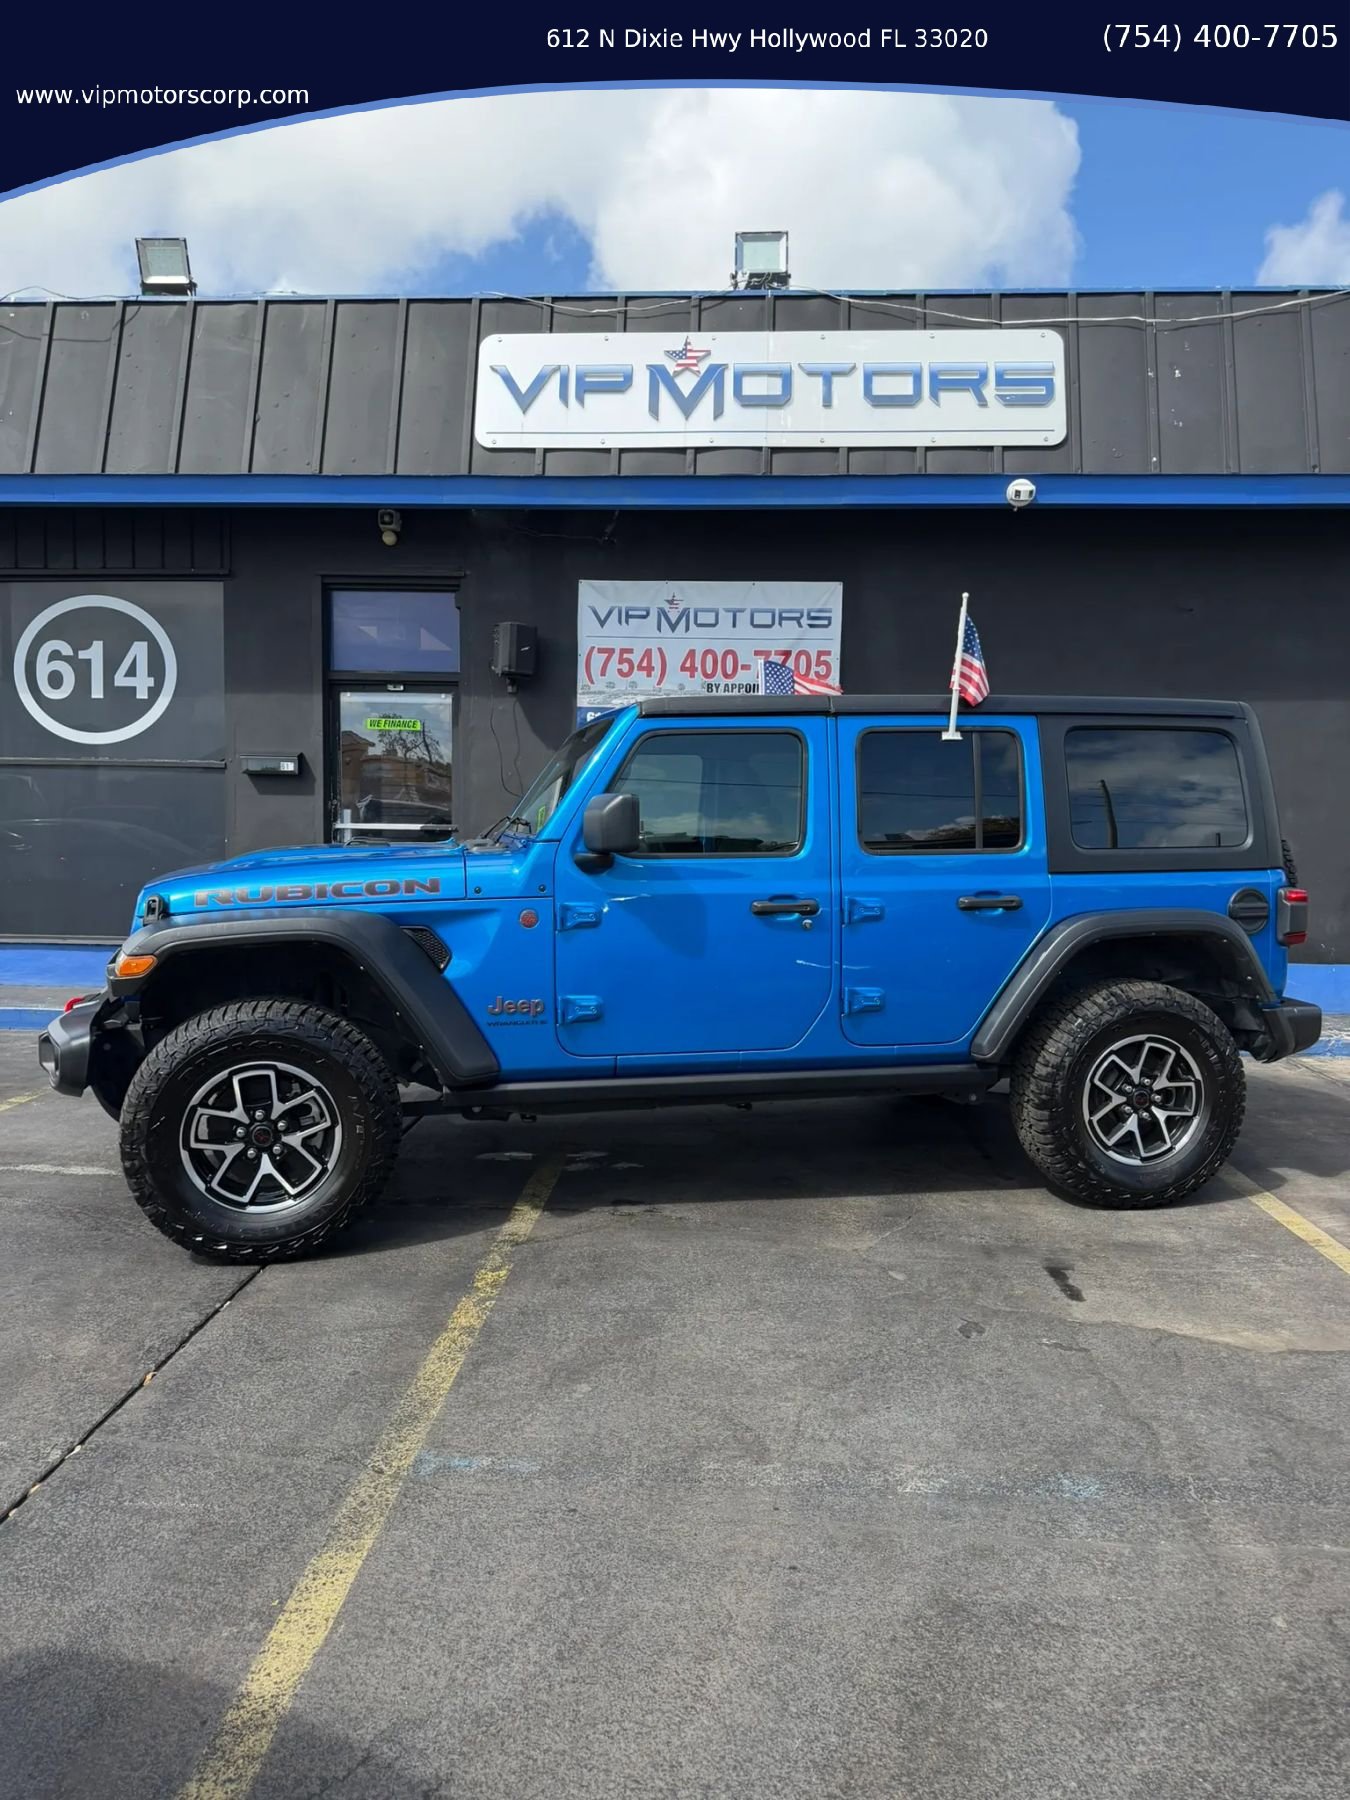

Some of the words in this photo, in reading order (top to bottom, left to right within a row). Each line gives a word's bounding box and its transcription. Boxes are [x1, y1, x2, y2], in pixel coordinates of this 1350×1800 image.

[490, 363, 634, 413] VIP
[647, 360, 1055, 421] MOTORS
[588, 605, 650, 629] VIP
[656, 606, 832, 633] MOTORS
[35, 639, 155, 700] 614
[584, 645, 667, 686] (754)
[706, 683, 720, 693] BY
[369, 720, 381, 728] WE
[383, 720, 417, 728] FINANCE
[194, 877, 441, 907] RUBICON
[487, 996, 545, 1017] Jeep
